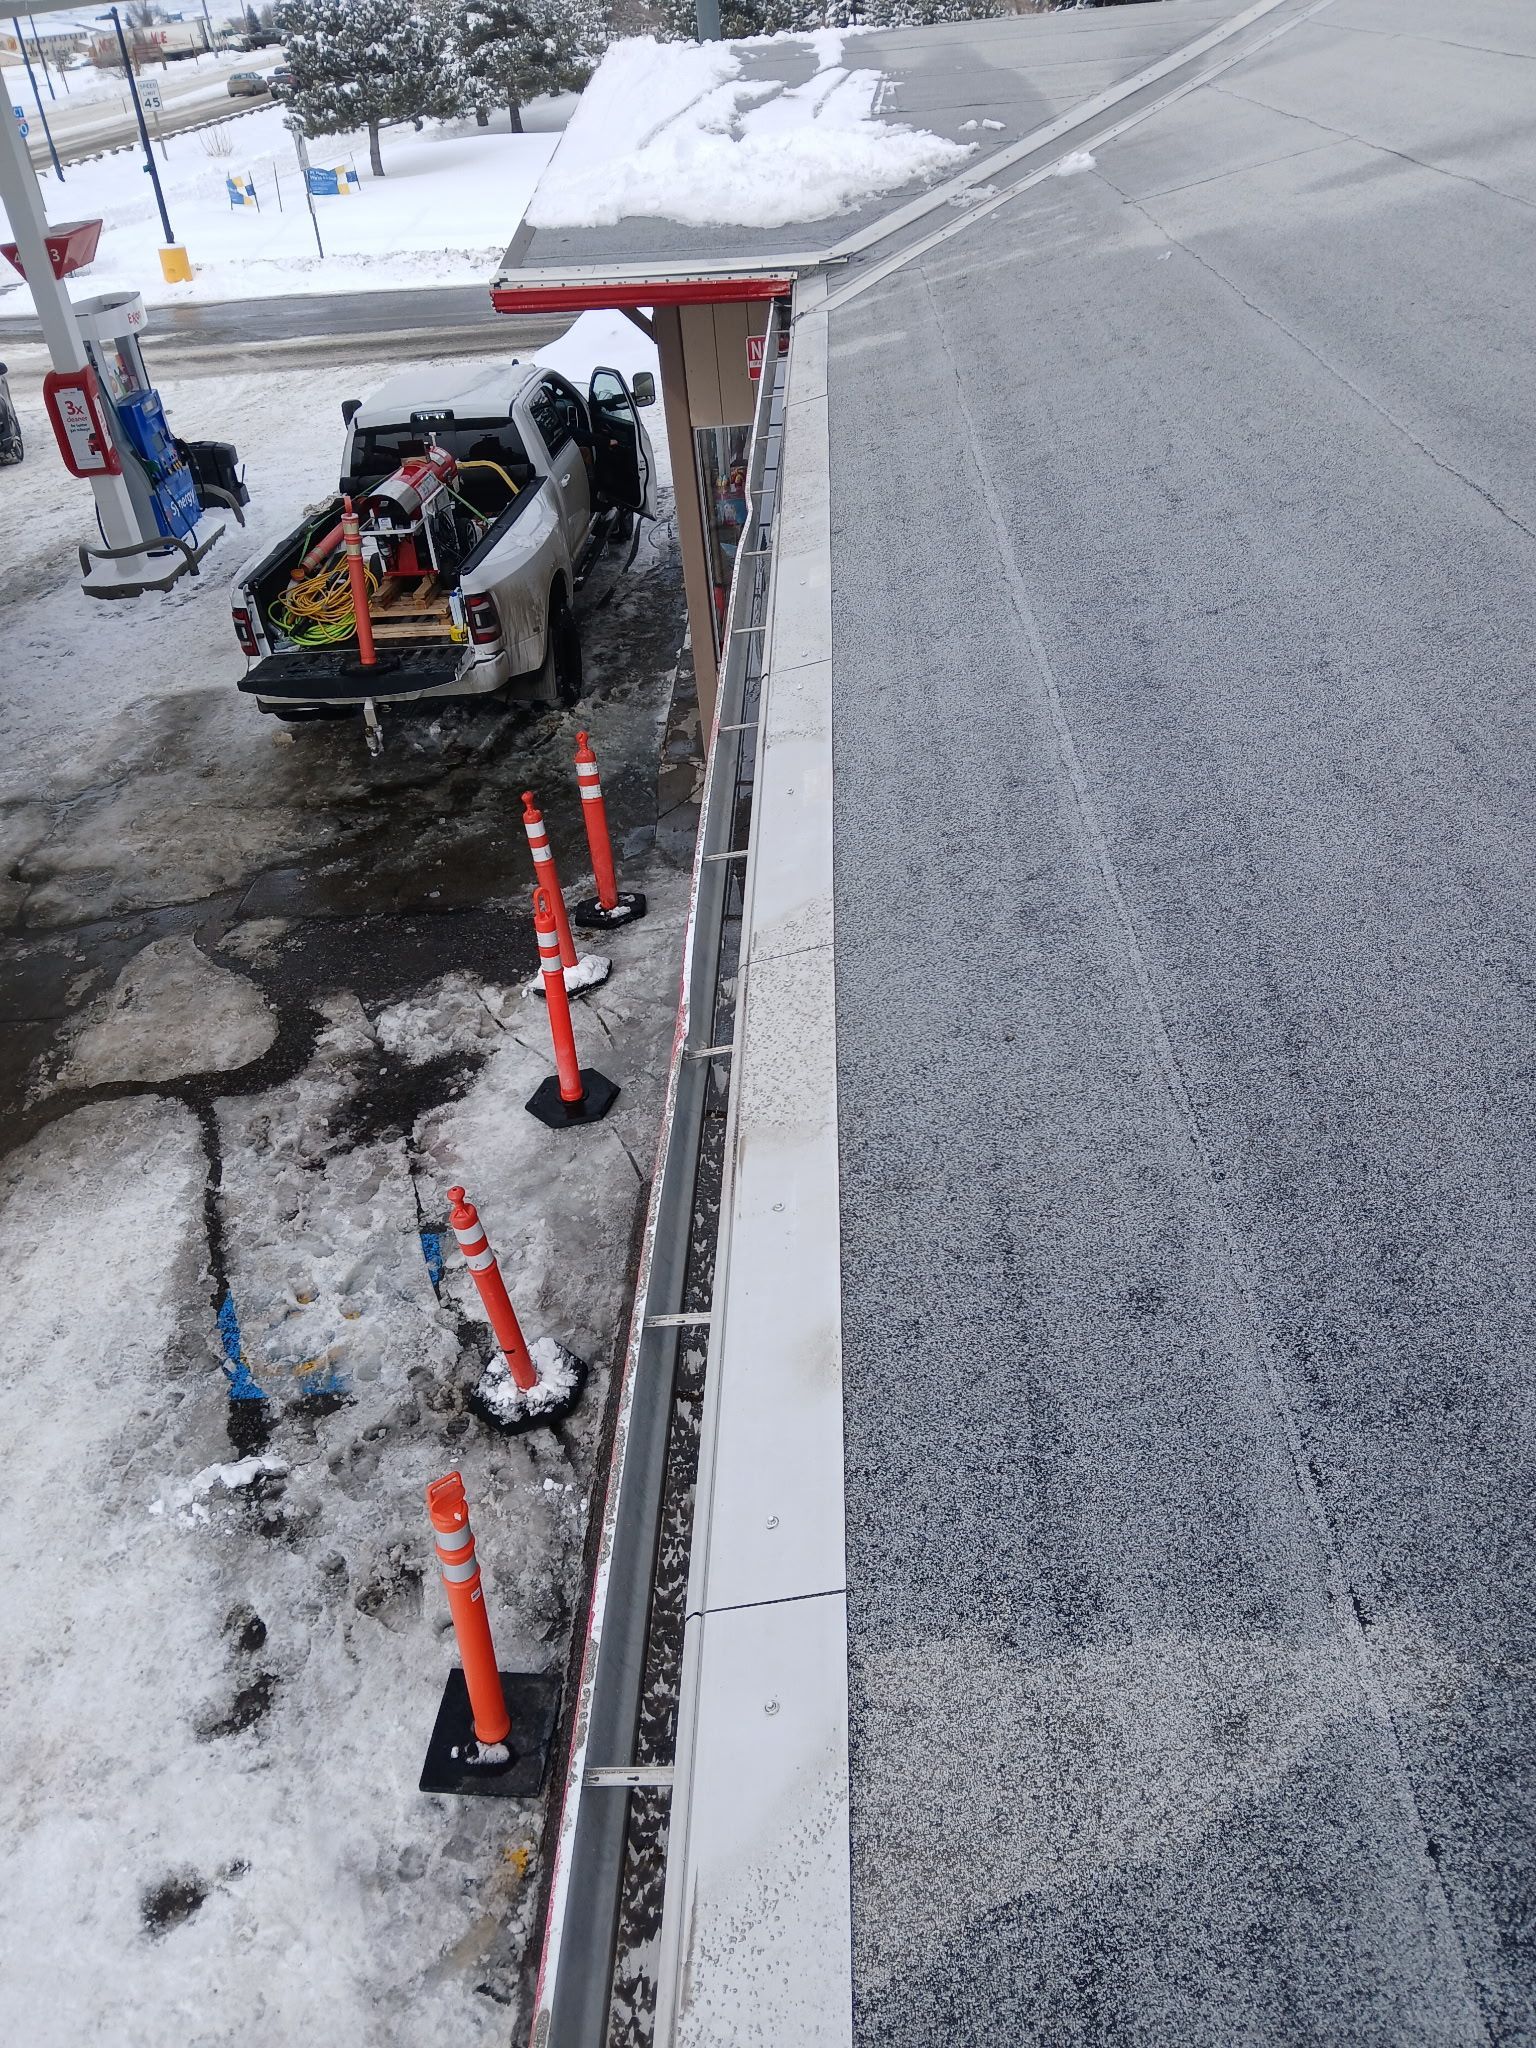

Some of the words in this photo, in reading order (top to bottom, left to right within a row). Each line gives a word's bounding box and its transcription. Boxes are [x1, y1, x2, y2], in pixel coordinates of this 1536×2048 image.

[144, 97, 161, 108] 45
[50, 248, 61, 262] 3
[751, 340, 766, 360] N
[64, 400, 85, 416] 3x
[170, 488, 197, 517] Synergy
